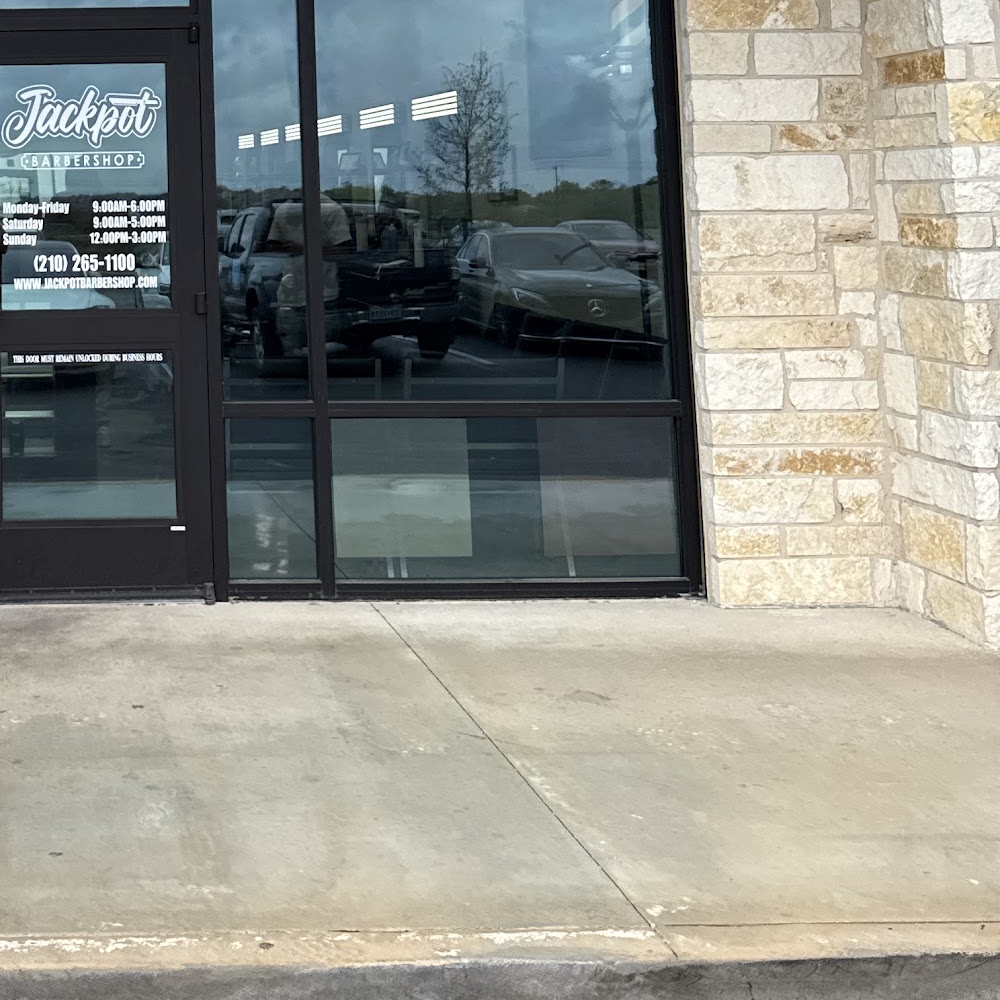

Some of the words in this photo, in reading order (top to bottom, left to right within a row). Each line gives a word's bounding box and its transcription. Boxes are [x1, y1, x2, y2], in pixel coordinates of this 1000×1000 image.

[5, 88, 159, 145] Jackpot
[31, 154, 135, 167] BARBERSHOP
[2, 202, 70, 214] Monday-Friday
[92, 200, 165, 212] 9:00AM-6:00PM
[2, 217, 44, 231] Saturday
[93, 216, 166, 228] 9:00AM-5:00PM
[2, 233, 38, 246] Sunday
[89, 231, 167, 244] 12:00PM-3:00PM
[33, 254, 69, 272] (210)
[72, 253, 136, 272] 265-1100
[13, 276, 158, 290] WWW.JACKPOTBARBERSHOP.COM
[12, 354, 25, 364] THIS
[25, 354, 40, 363] DOOR
[40, 354, 55, 363] MUST
[55, 353, 75, 363] REMAIN
[75, 353, 102, 363] UNLOCKED
[102, 353, 121, 362] DURING
[122, 352, 145, 362] BUSINESS
[146, 352, 163, 362] HOURS
